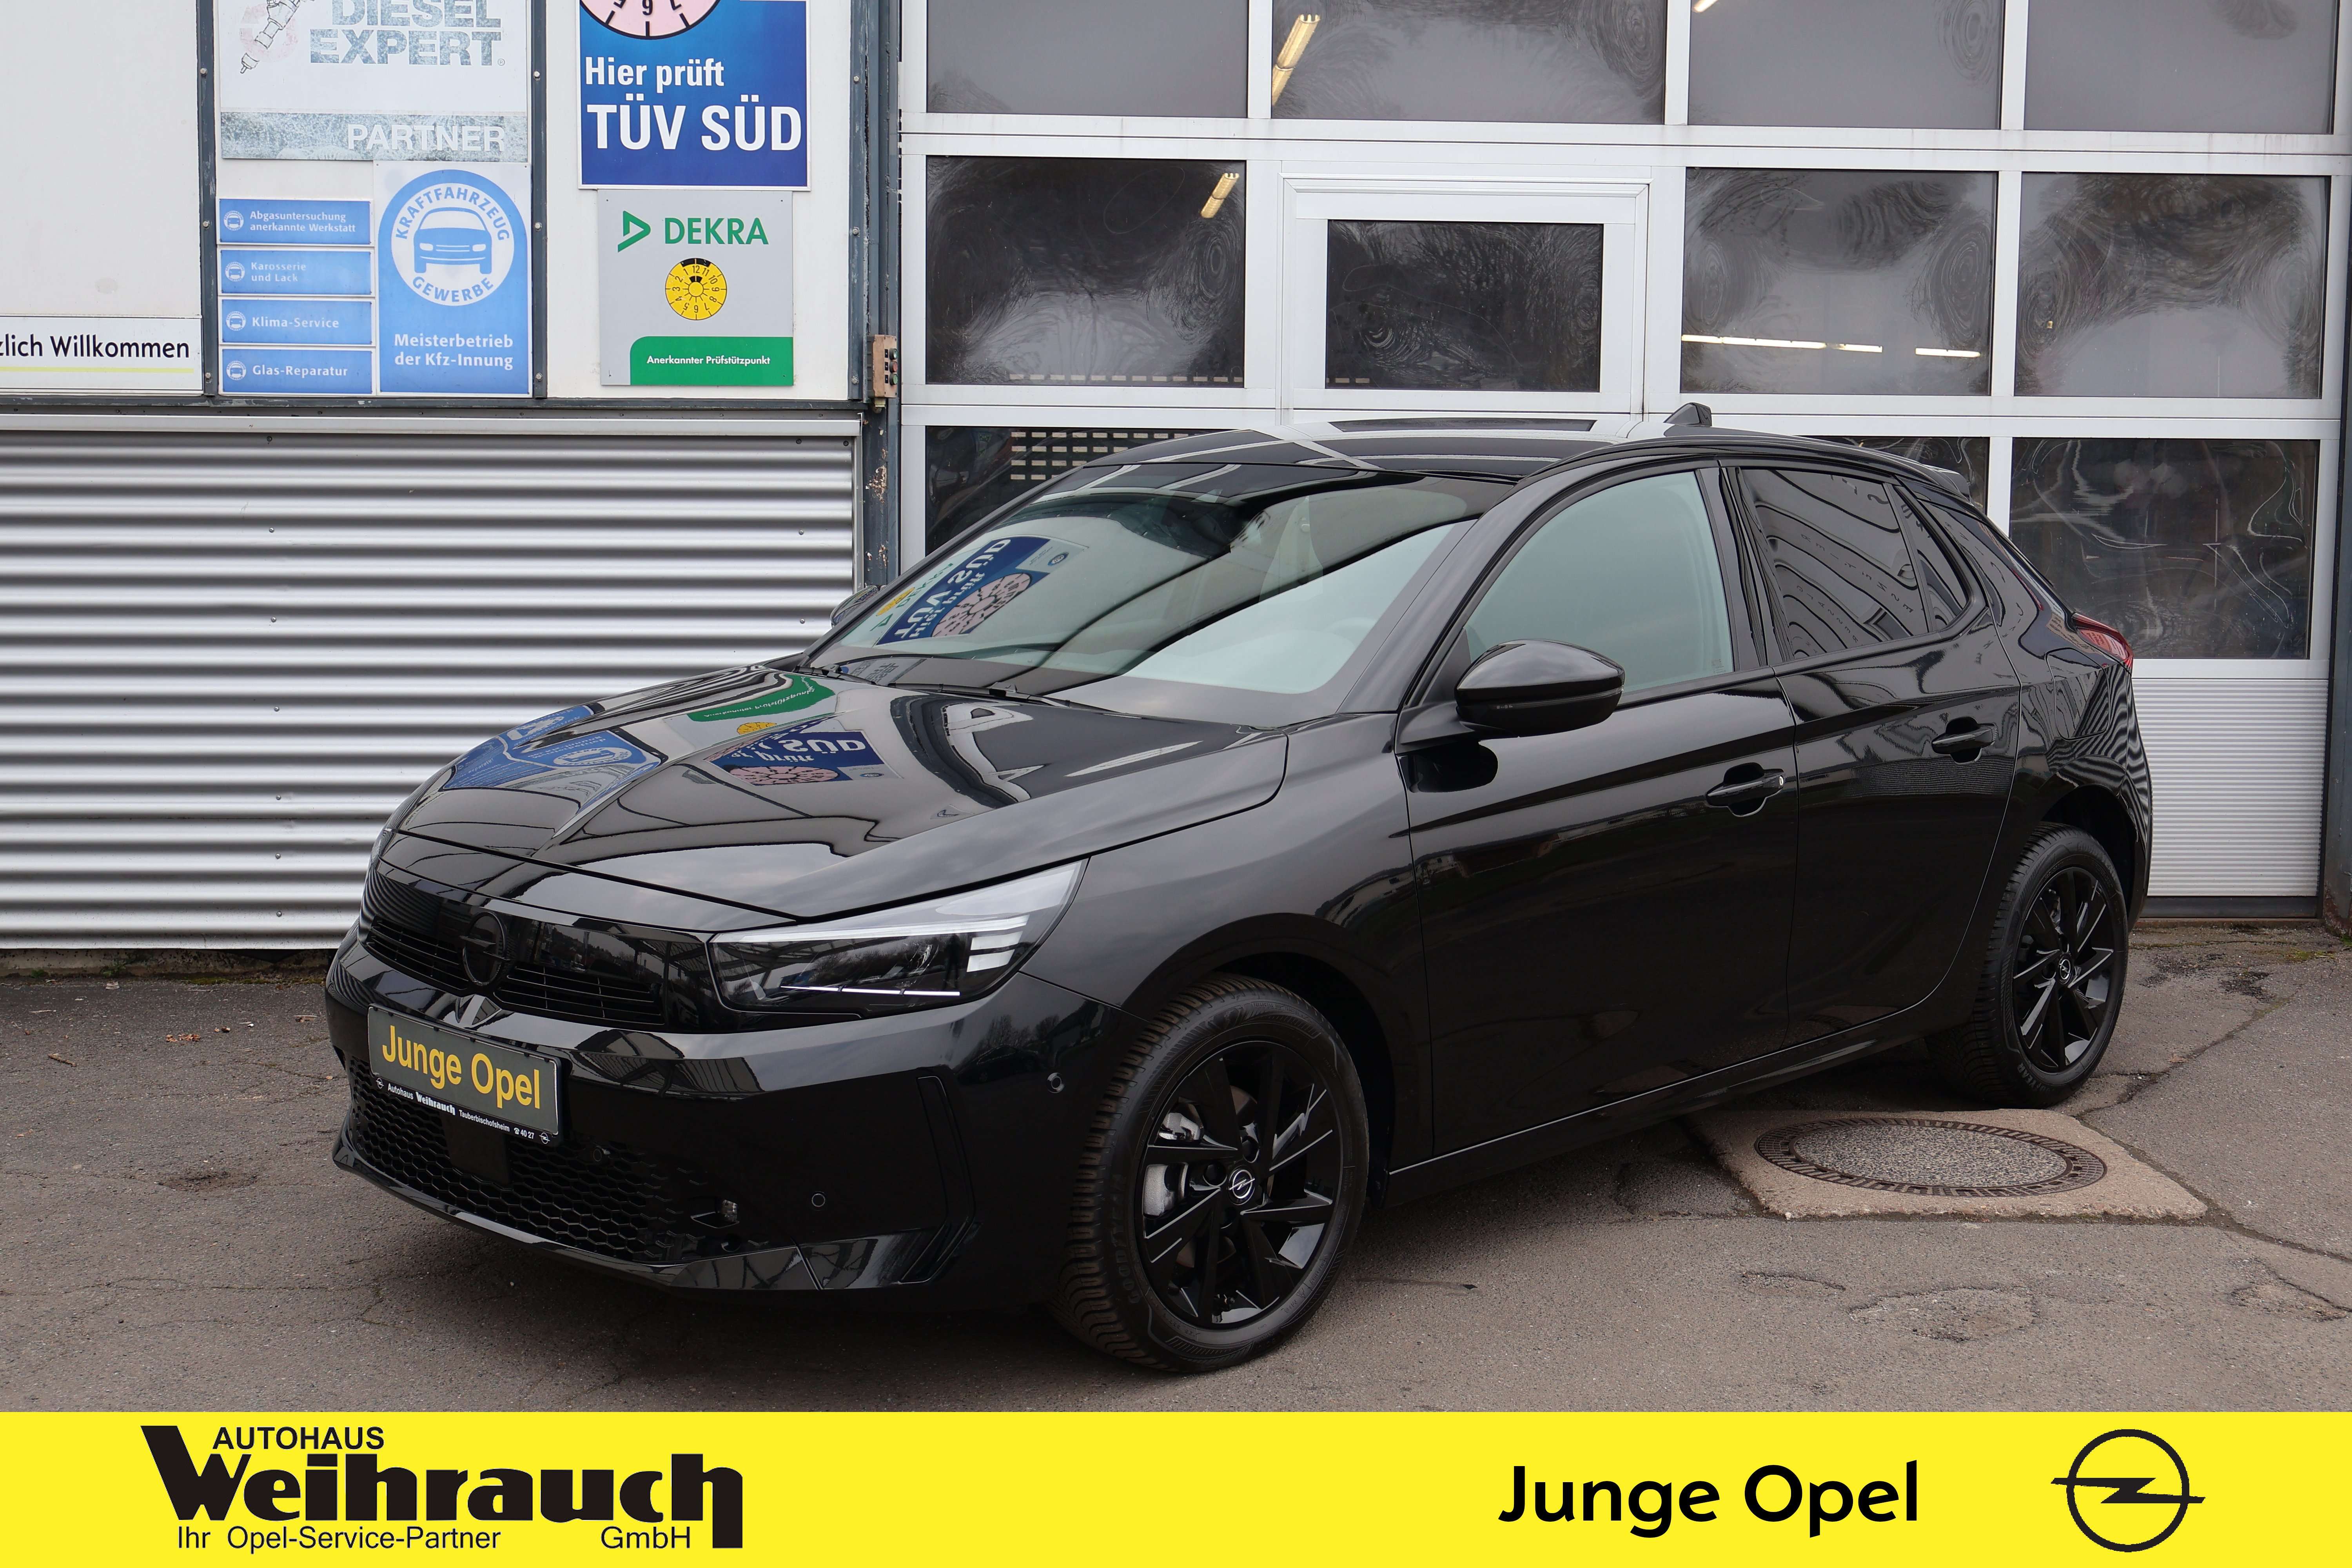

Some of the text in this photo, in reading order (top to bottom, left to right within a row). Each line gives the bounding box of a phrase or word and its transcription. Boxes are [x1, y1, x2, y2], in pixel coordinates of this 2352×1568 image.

[332, 0, 501, 27] DIESEL
[586, 57, 724, 93] Hier prüft
[587, 93, 802, 151] TÜV SÜD
[348, 124, 505, 151] PARTNER
[250, 211, 346, 223] Abgasuntersuchung
[396, 187, 510, 240] KRAFTFAHRZEUG
[250, 223, 305, 231] anerkannte
[665, 217, 769, 245] DEKRA
[251, 262, 306, 270] Karosserie
[412, 276, 494, 302] GEWERBE
[252, 316, 339, 328] Klima-Service
[50, 334, 189, 358] Willkommen
[394, 333, 513, 348] Meisterbetrieb
[252, 365, 348, 378] Glas-Reparatur
[395, 352, 513, 370] der Kfz-Innung
[646, 356, 770, 366] Anerkannter Prüfstützpunkt
[382, 1025, 540, 1109] Junge Opel
[388, 1083, 414, 1100] Autohaus
[416, 1092, 456, 1116] Weihrauch
[459, 1109, 510, 1132] Tauberbischofsheim
